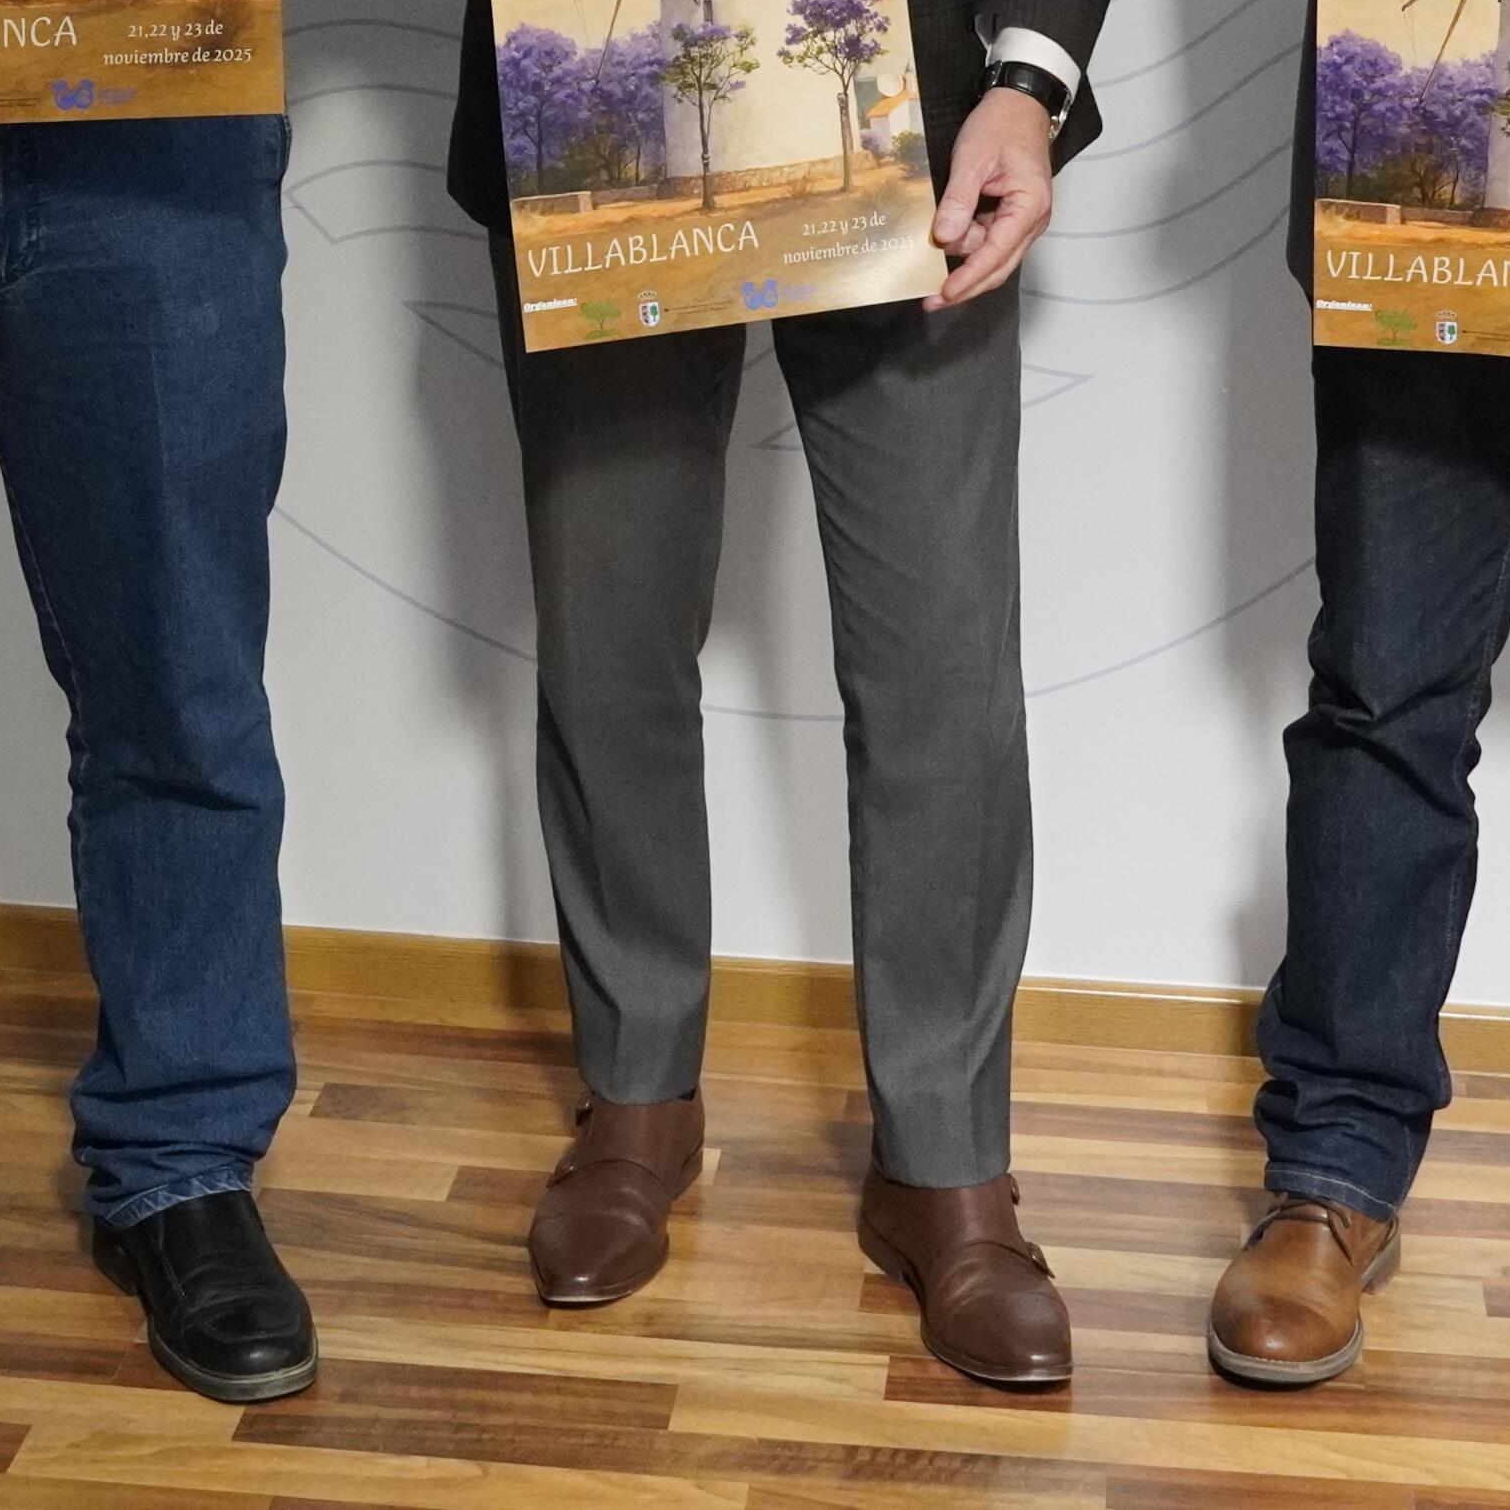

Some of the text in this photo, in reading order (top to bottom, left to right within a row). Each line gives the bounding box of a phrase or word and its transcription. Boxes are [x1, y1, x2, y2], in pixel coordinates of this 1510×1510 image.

[171, 25, 180, 40] y
[184, 23, 202, 37] 23
[205, 19, 223, 35] de
[104, 47, 252, 65] noviembre de 2025
[839, 220, 848, 234] y
[852, 217, 866, 230] 23
[870, 211, 886, 226] de
[527, 219, 760, 279] VILLABLANCA
[783, 242, 858, 264] noviembre
[861, 238, 877, 253] de
